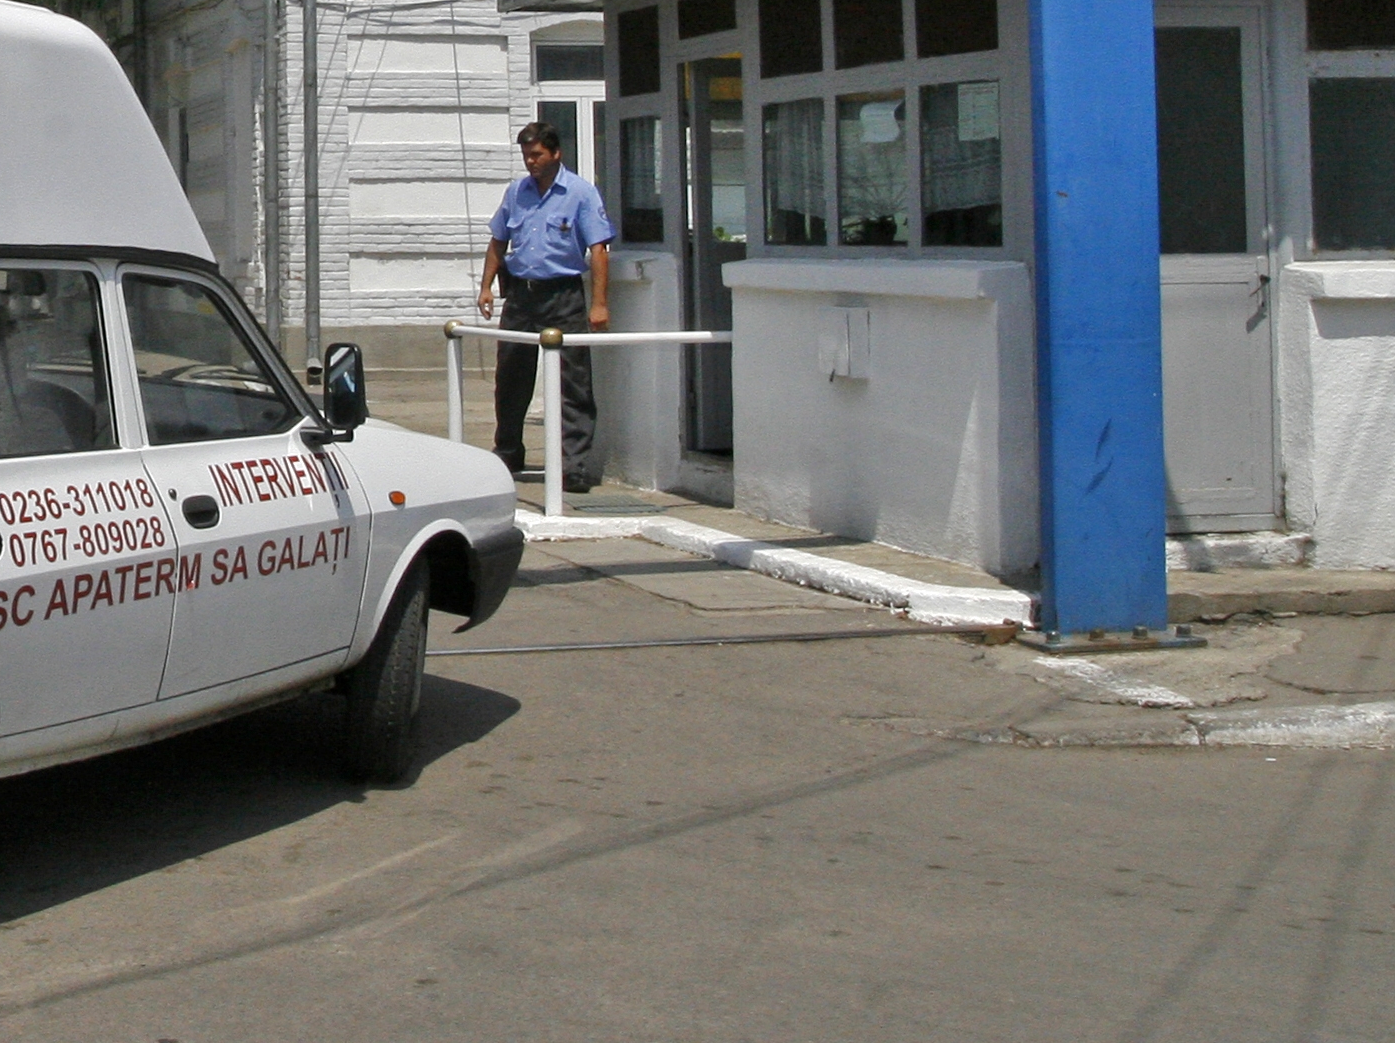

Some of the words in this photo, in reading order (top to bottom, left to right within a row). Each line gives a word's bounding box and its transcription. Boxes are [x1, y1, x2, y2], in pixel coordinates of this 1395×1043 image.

[9, 516, 165, 567] 0767-809028
[44, 553, 202, 621] APATERM
[210, 545, 248, 586] SA
[257, 526, 350, 576] GALAȚI
